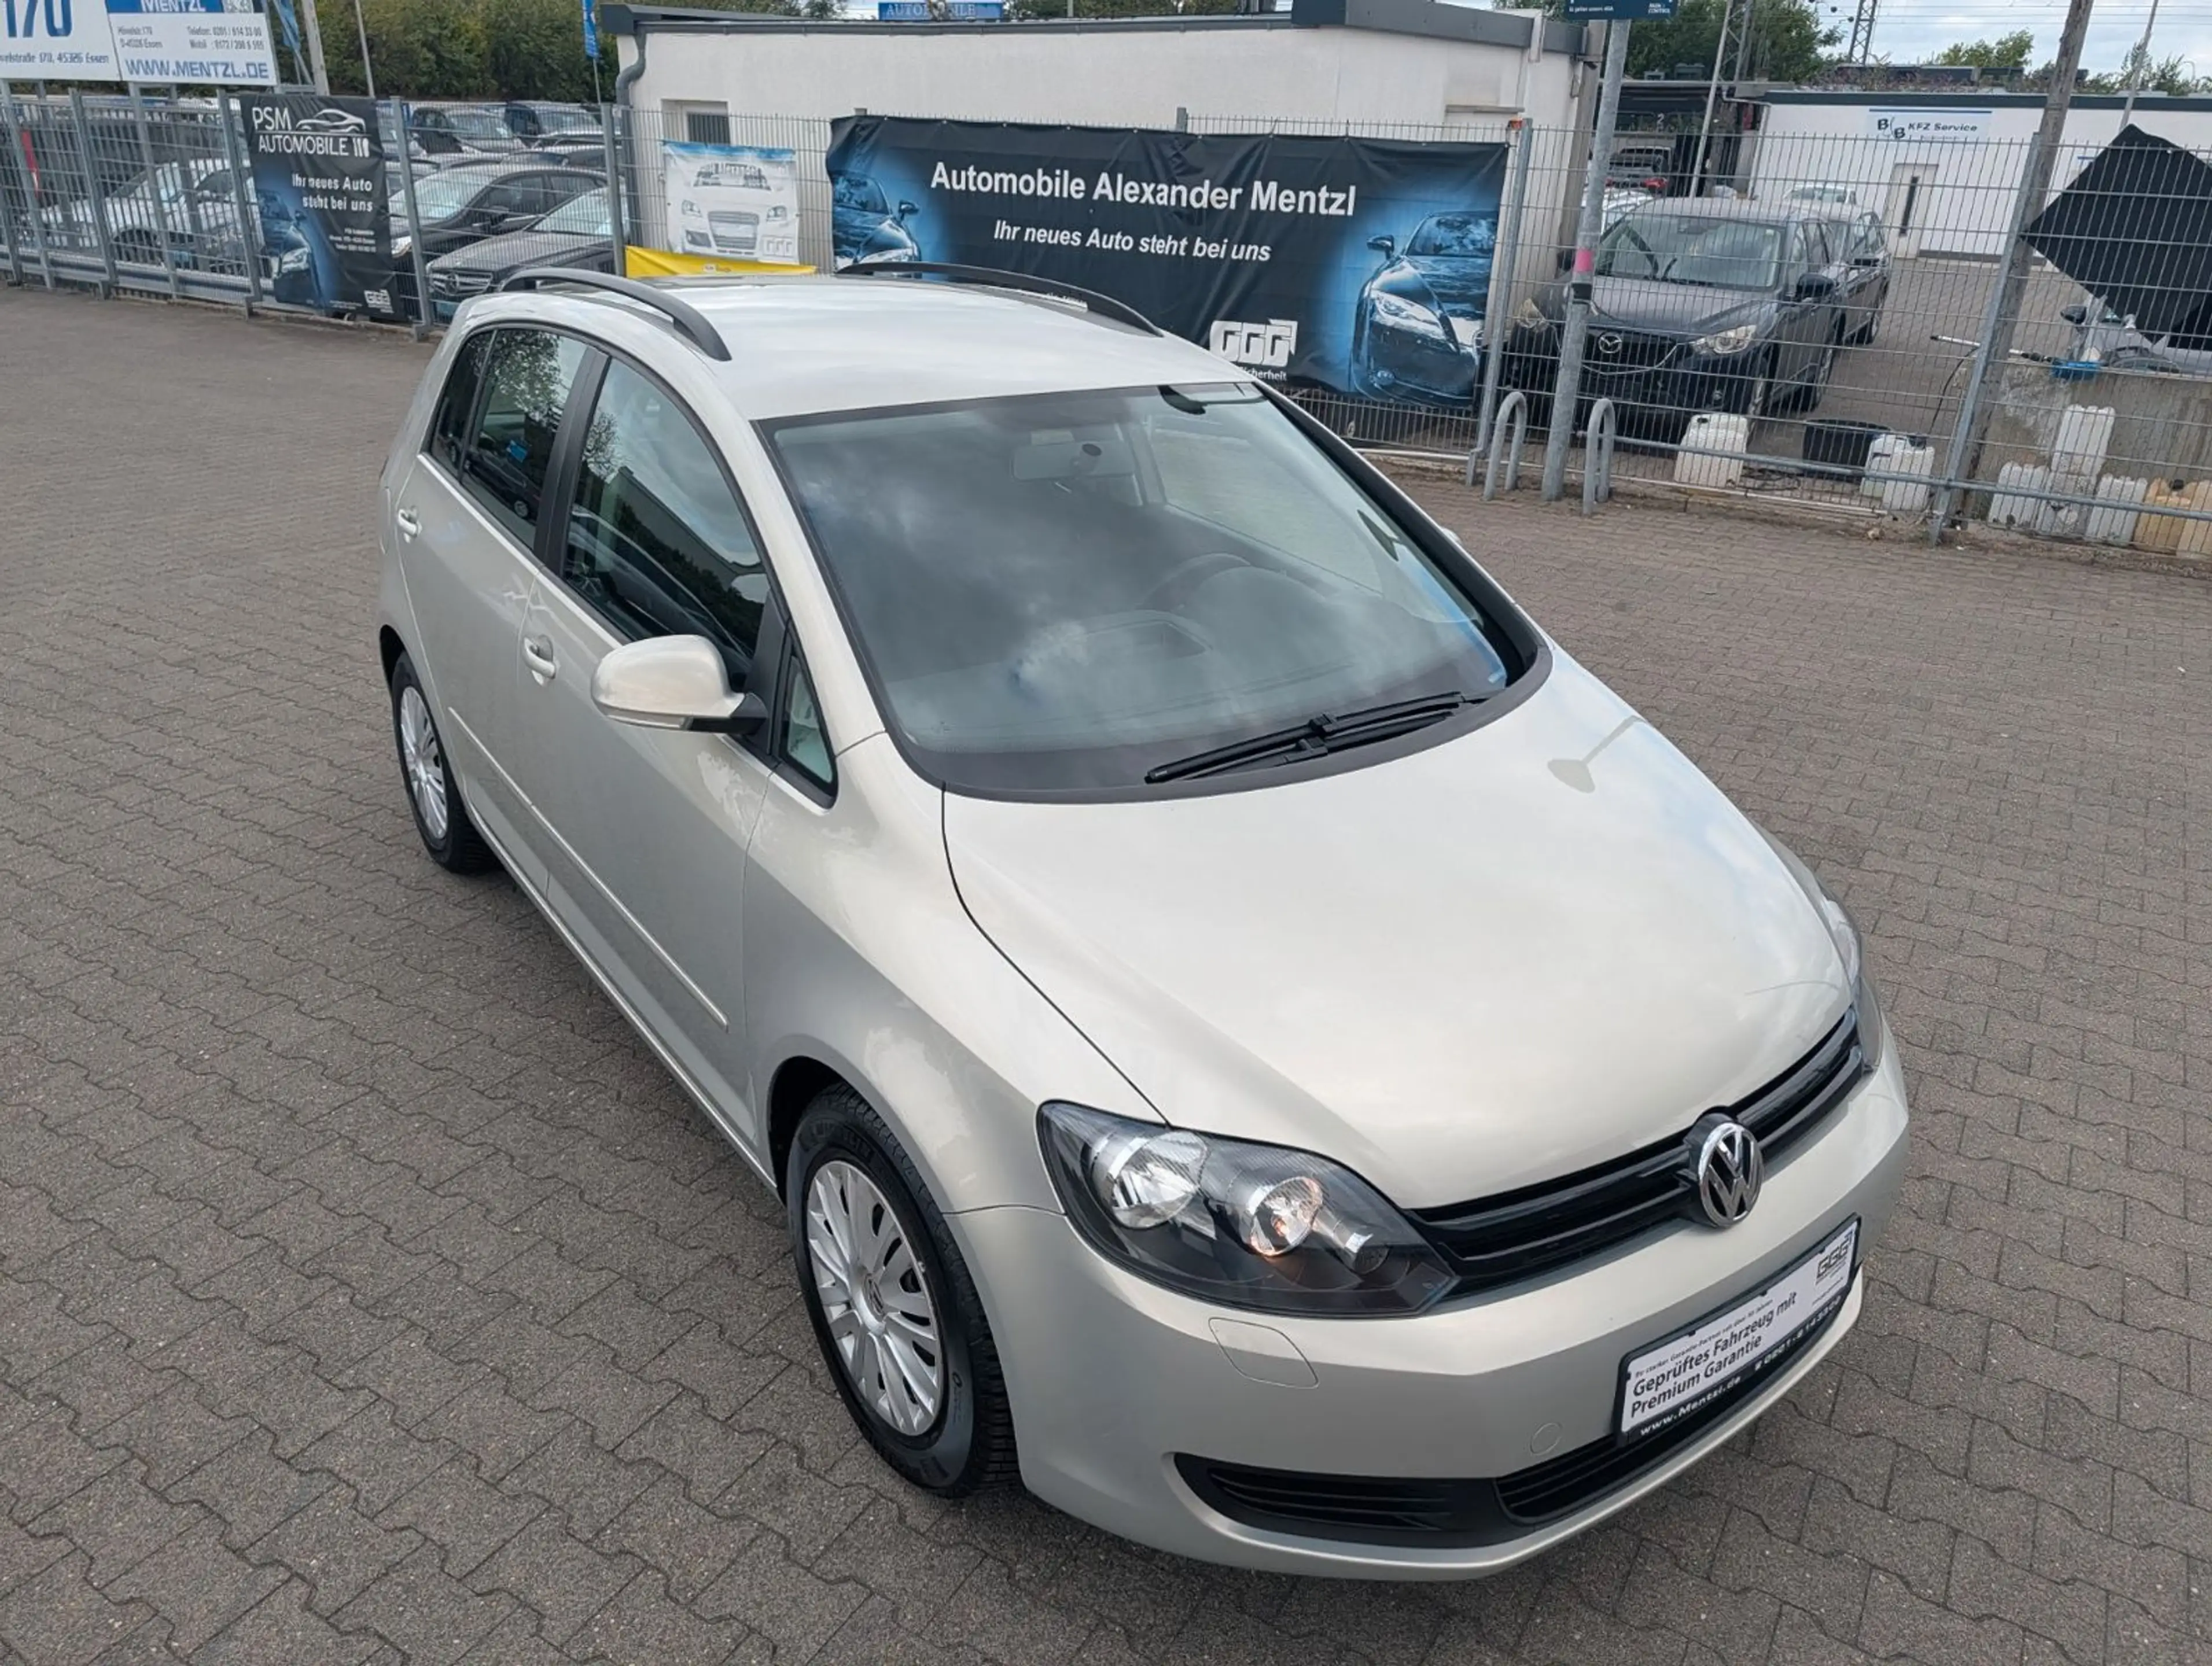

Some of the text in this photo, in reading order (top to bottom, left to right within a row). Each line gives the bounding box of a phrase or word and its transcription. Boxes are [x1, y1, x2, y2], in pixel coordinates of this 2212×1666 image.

[886, 4, 976, 16] AUTOILE
[126, 60, 269, 79] WWW.MENTZL.DE
[252, 106, 292, 131] PSM
[1908, 123, 1931, 131] KFZ
[1934, 123, 1978, 131] Service
[259, 134, 349, 156] AUTOMOBILE
[292, 173, 373, 191] Ihr neues Auto
[931, 161, 1356, 216] Automobile Alexander Mentzl
[302, 195, 373, 212] steht bei uns
[994, 219, 1272, 261] Ihr neues Auto steht bei uns
[1240, 366, 1287, 381] cherheit
[1633, 1292, 1797, 1397] Geprüftes Fahrzeug mit
[1631, 1335, 1762, 1418] Premium Garantie
